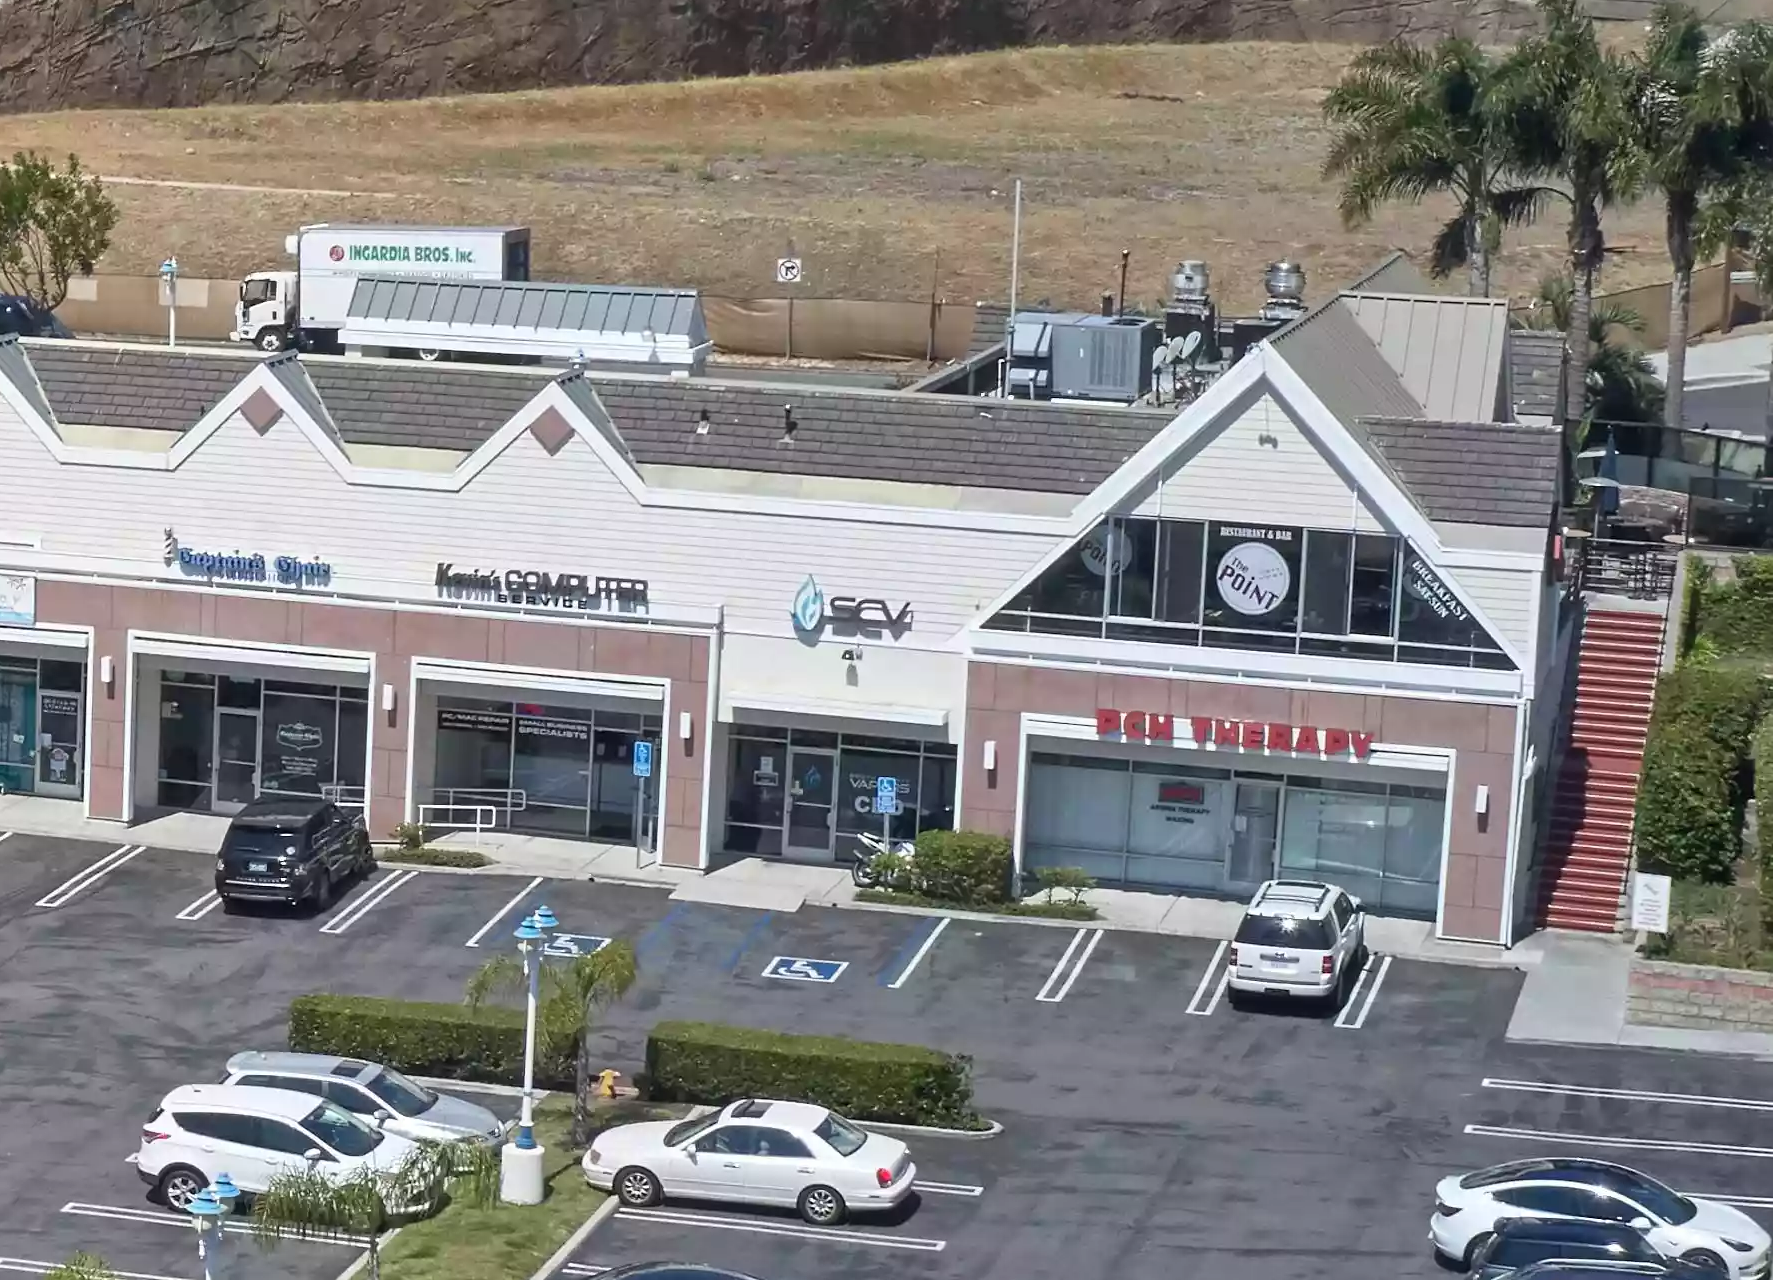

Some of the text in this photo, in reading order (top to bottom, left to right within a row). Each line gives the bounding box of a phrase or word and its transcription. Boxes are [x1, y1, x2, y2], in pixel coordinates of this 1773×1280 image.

[349, 244, 411, 262] INGARDIA
[414, 246, 454, 263] BROS.
[1220, 526, 1266, 539] RESTAURANT
[1275, 530, 1292, 540] BAR
[435, 562, 649, 604] Kevin's COMPUTER
[1412, 560, 1469, 621] BREAKFAST
[498, 593, 588, 610] SERVICE
[518, 726, 588, 740] SPECIALISTS
[1095, 708, 1376, 758] PCH THERAPY
[849, 778, 911, 794] VAPS
